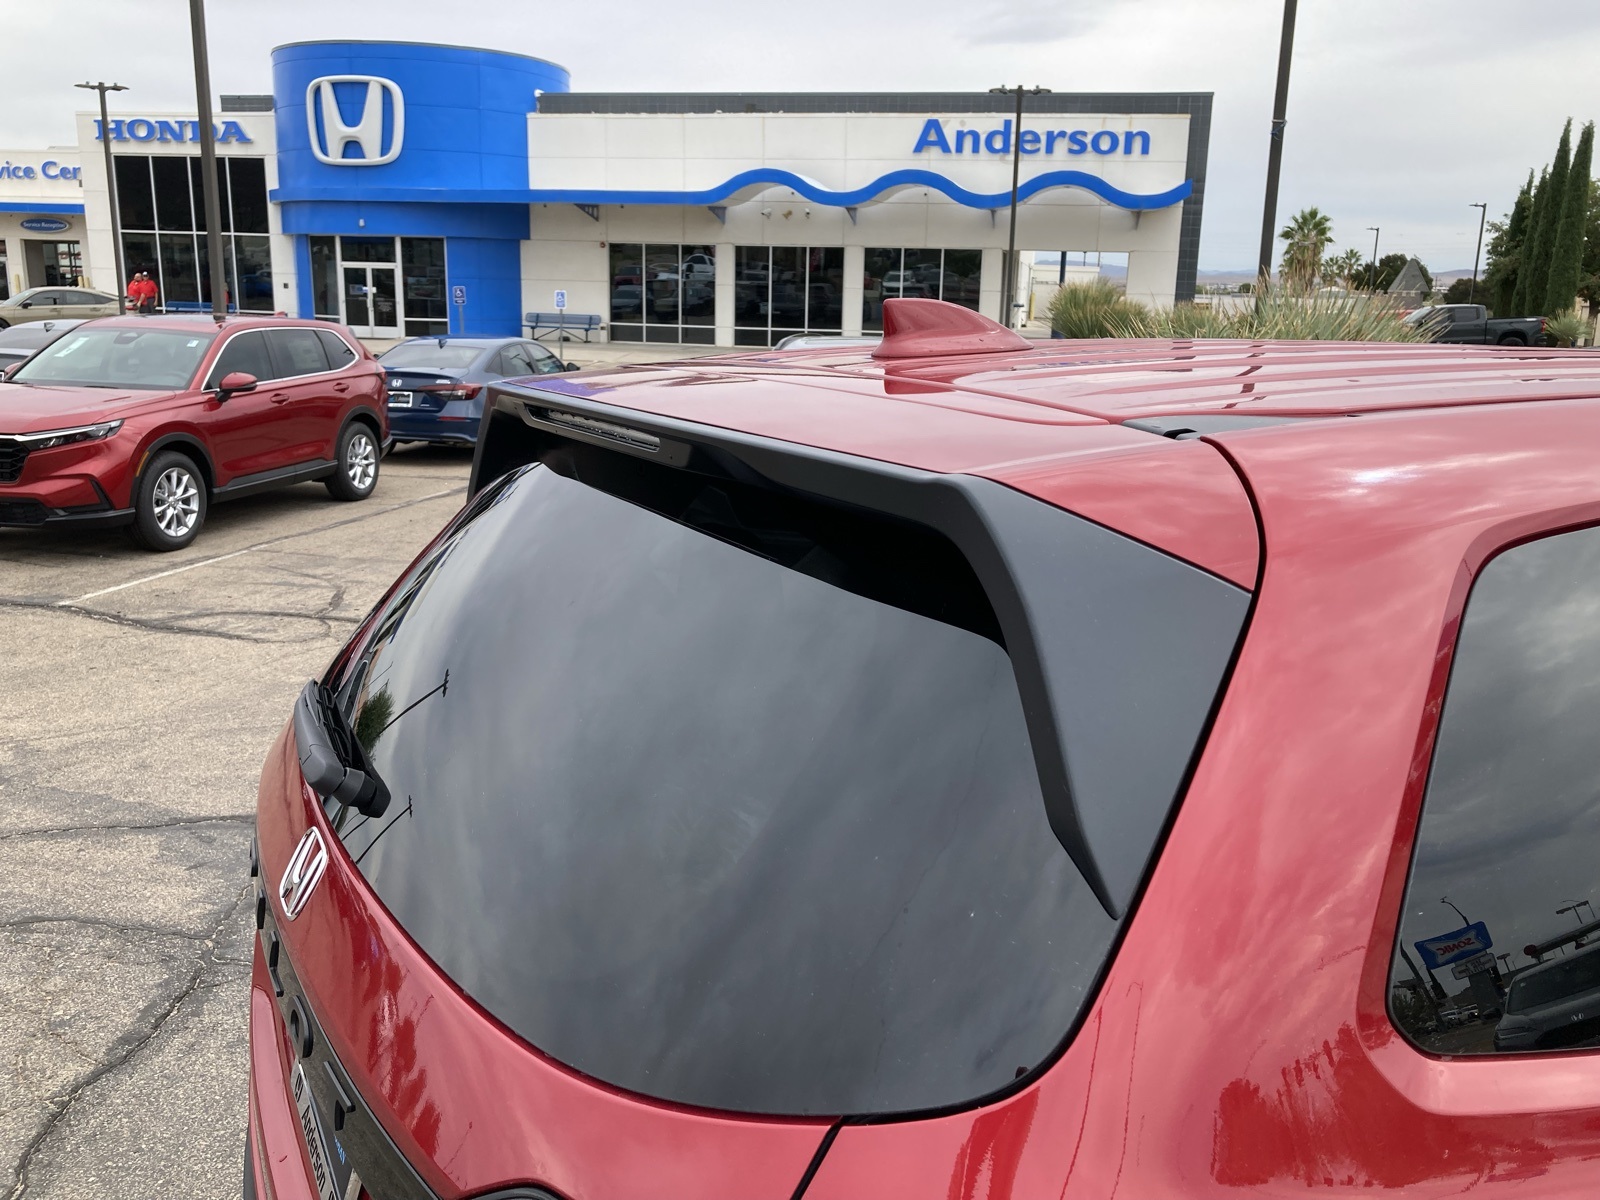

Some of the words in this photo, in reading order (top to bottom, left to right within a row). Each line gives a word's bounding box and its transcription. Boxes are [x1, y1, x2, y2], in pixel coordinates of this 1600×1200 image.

[93, 118, 252, 143] HONDA
[912, 118, 1151, 155] Anderson
[299, 1104, 326, 1193] Anderson
